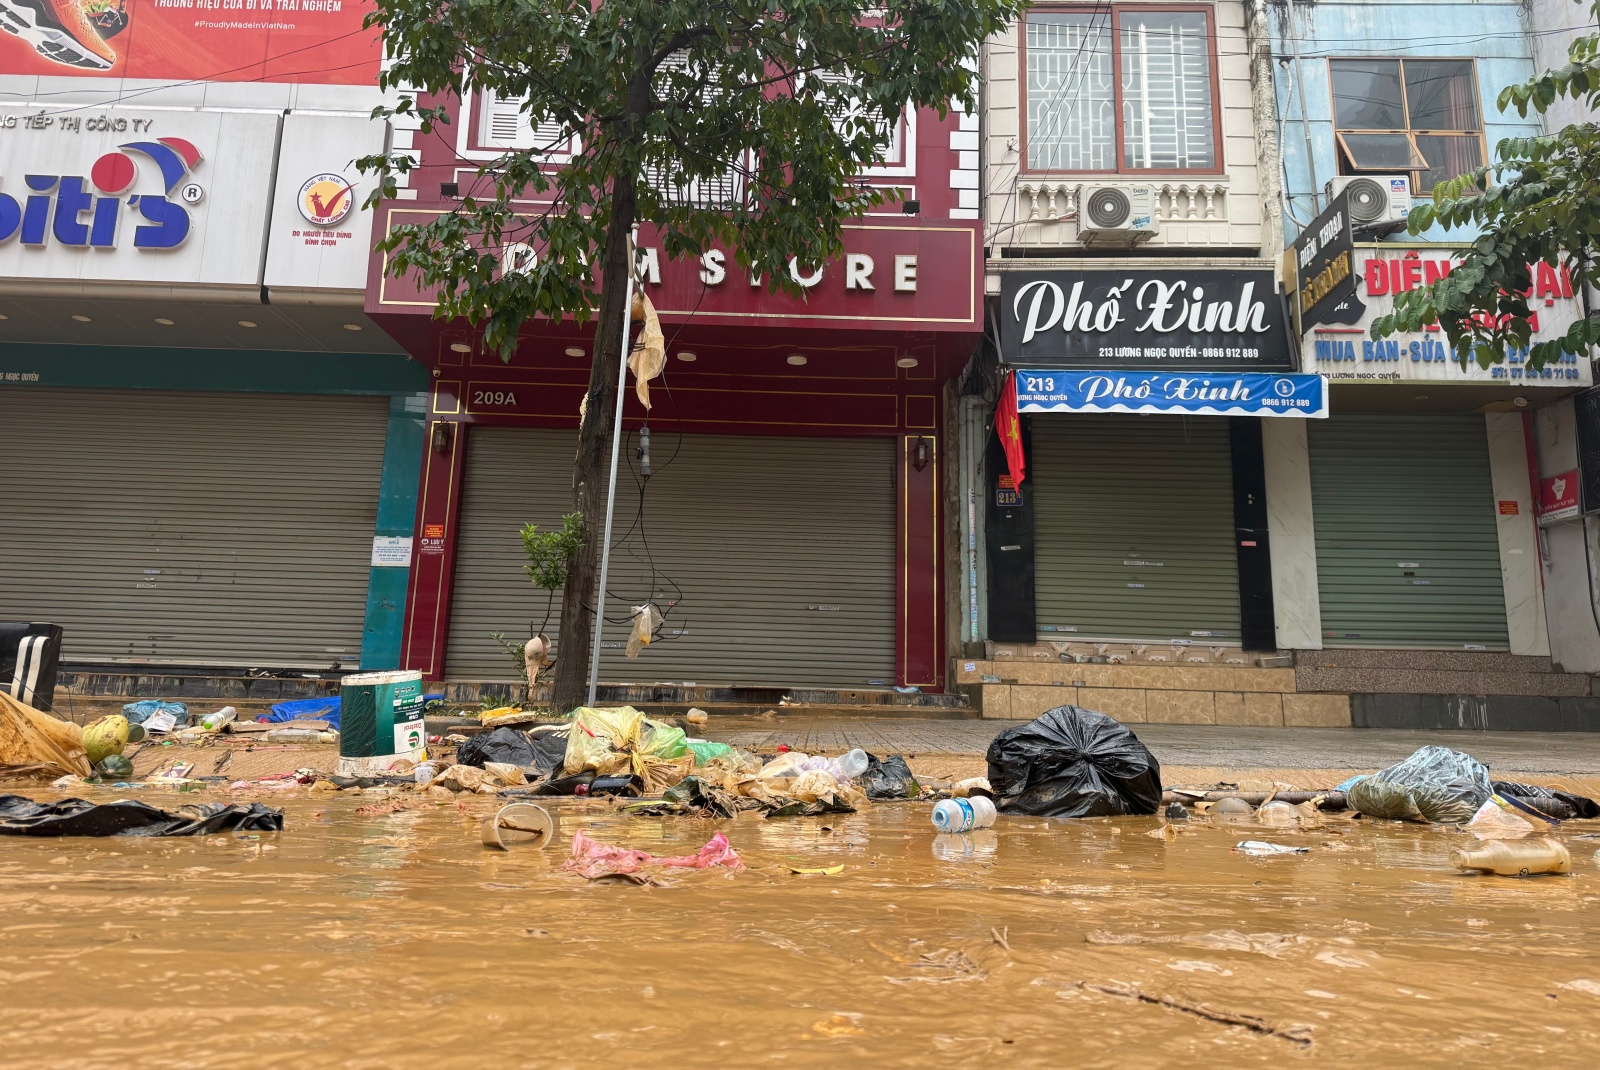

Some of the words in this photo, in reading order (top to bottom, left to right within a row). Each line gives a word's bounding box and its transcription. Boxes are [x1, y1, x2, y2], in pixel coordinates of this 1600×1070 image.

[194, 20, 295, 30] #ProudlyMadeInVietNam
[24, 110, 53, 130] TIẾP
[59, 116, 81, 133] THỊ
[86, 115, 127, 132] CÔNG
[133, 118, 153, 132] TY
[329, 176, 341, 184] NAM
[336, 231, 352, 239] DÙNG
[1013, 278, 1134, 344] Phố
[1134, 279, 1271, 334] Xinh
[1099, 347, 1113, 357] 213
[1115, 346, 1141, 358] LƯƠNG
[1144, 348, 1167, 359] NGỌC
[1169, 345, 1197, 358] QUYẾN
[1203, 348, 1224, 358] 0866
[1226, 348, 1241, 358] 912
[1243, 348, 1259, 358] 889
[1315, 340, 1356, 362] MUA
[1332, 371, 1355, 379] LƯƠNG
[1356, 372, 1376, 380] NGỌC
[1378, 370, 1401, 380] QUYẾN
[1027, 377, 1055, 392] 213
[1078, 376, 1160, 402] Phố
[1164, 377, 1253, 401] Xinh
[473, 391, 517, 405] 209A
[1262, 398, 1280, 406] 0866
[1296, 399, 1310, 407] 889
[403, 722, 422, 732] Castrol
